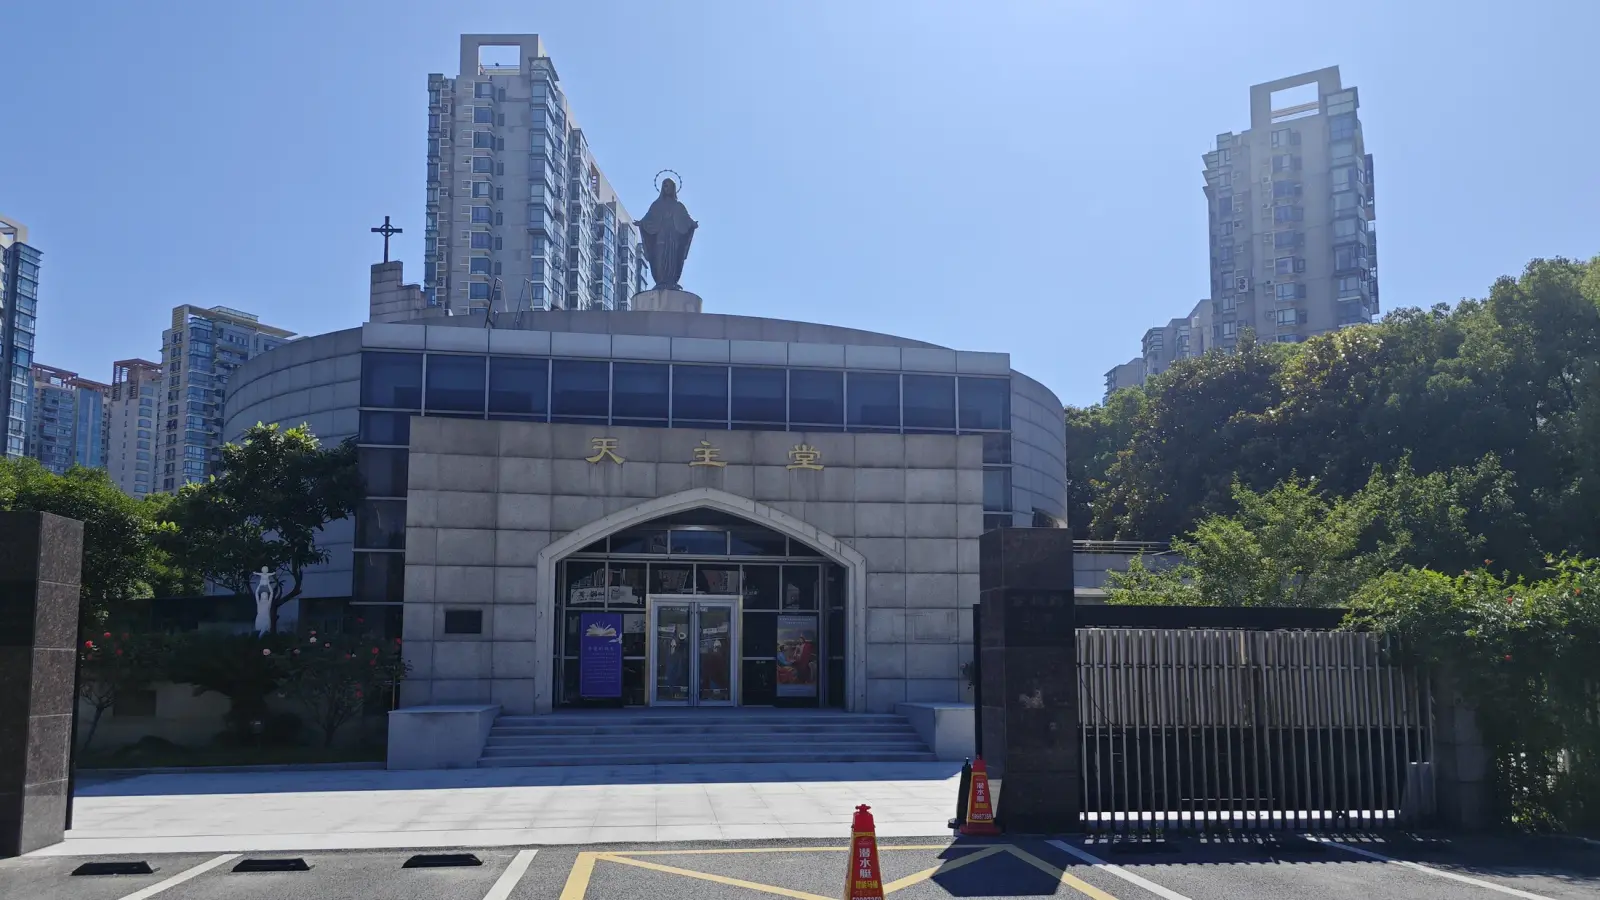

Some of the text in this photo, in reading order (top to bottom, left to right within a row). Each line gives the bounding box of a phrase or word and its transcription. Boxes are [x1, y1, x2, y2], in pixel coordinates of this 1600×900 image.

[586, 437, 824, 471] 天主堂
[859, 848, 872, 879] 潜水艇
